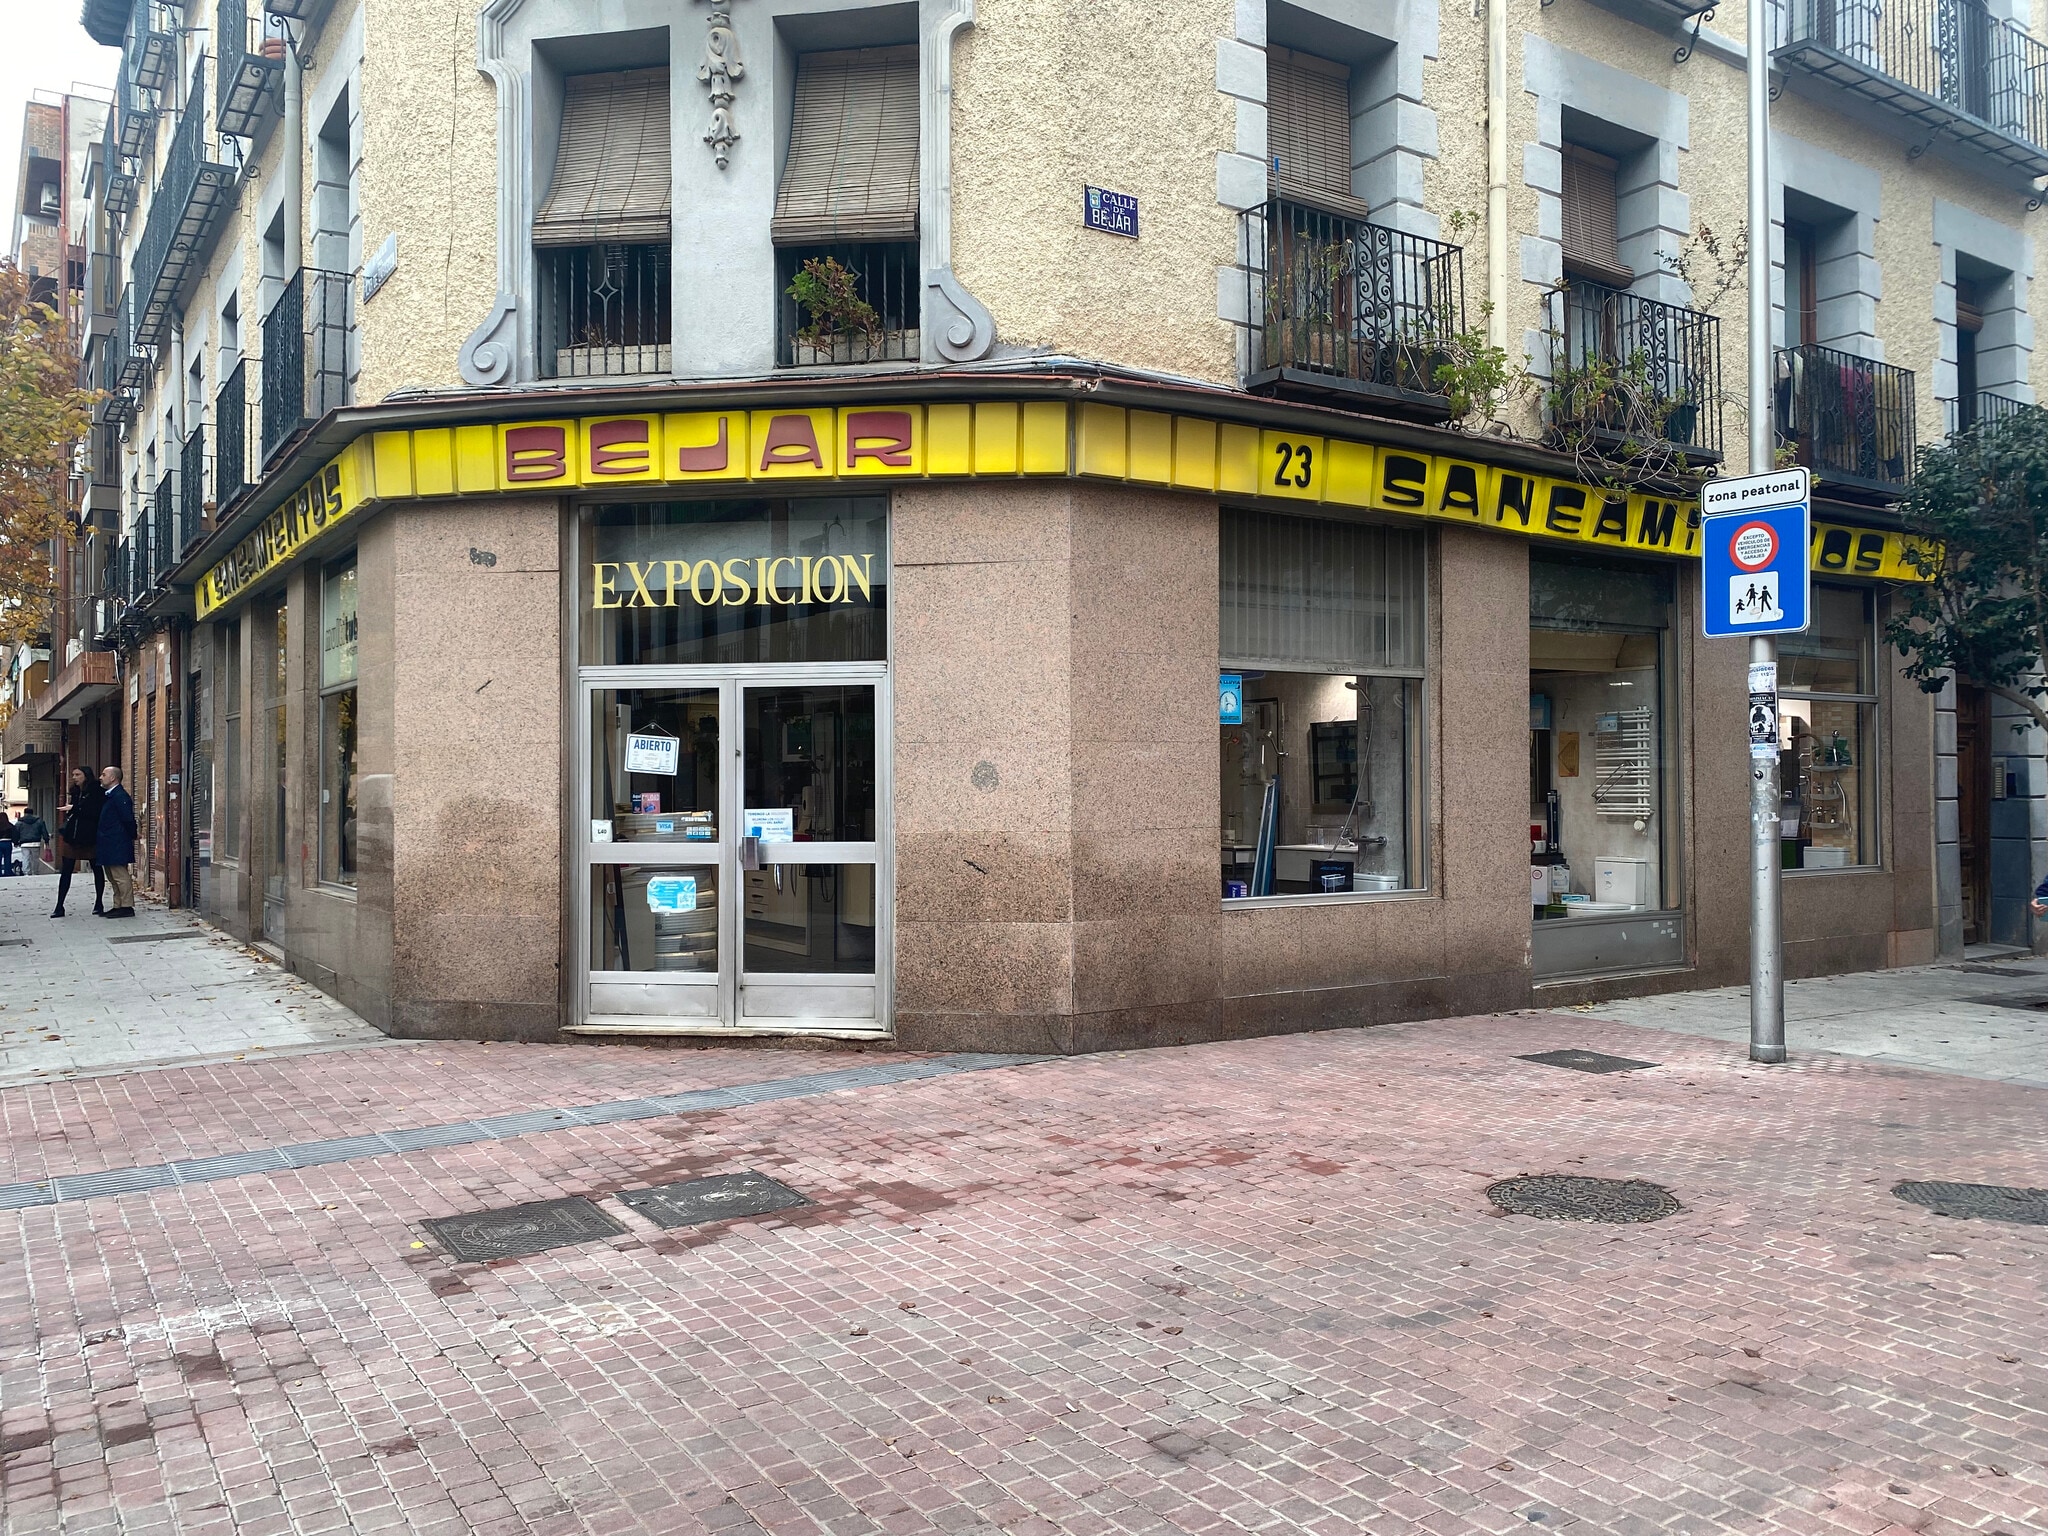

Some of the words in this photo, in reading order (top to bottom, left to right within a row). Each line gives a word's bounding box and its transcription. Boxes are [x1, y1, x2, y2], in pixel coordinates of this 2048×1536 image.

[1102, 193, 1136, 211] CALLE
[1113, 206, 1126, 215] DE
[504, 410, 912, 482] BEJAR
[1274, 441, 1313, 488] 23
[1708, 491, 1737, 503] zona
[1741, 479, 1800, 500] peatonal
[1382, 455, 1885, 572] SANEAMIOS
[1737, 543, 1771, 551] EMERGENCIAS
[1743, 533, 1765, 541] EXCEPTO
[592, 553, 875, 608] EXPOSICION
[633, 739, 672, 752] ABIERTO
